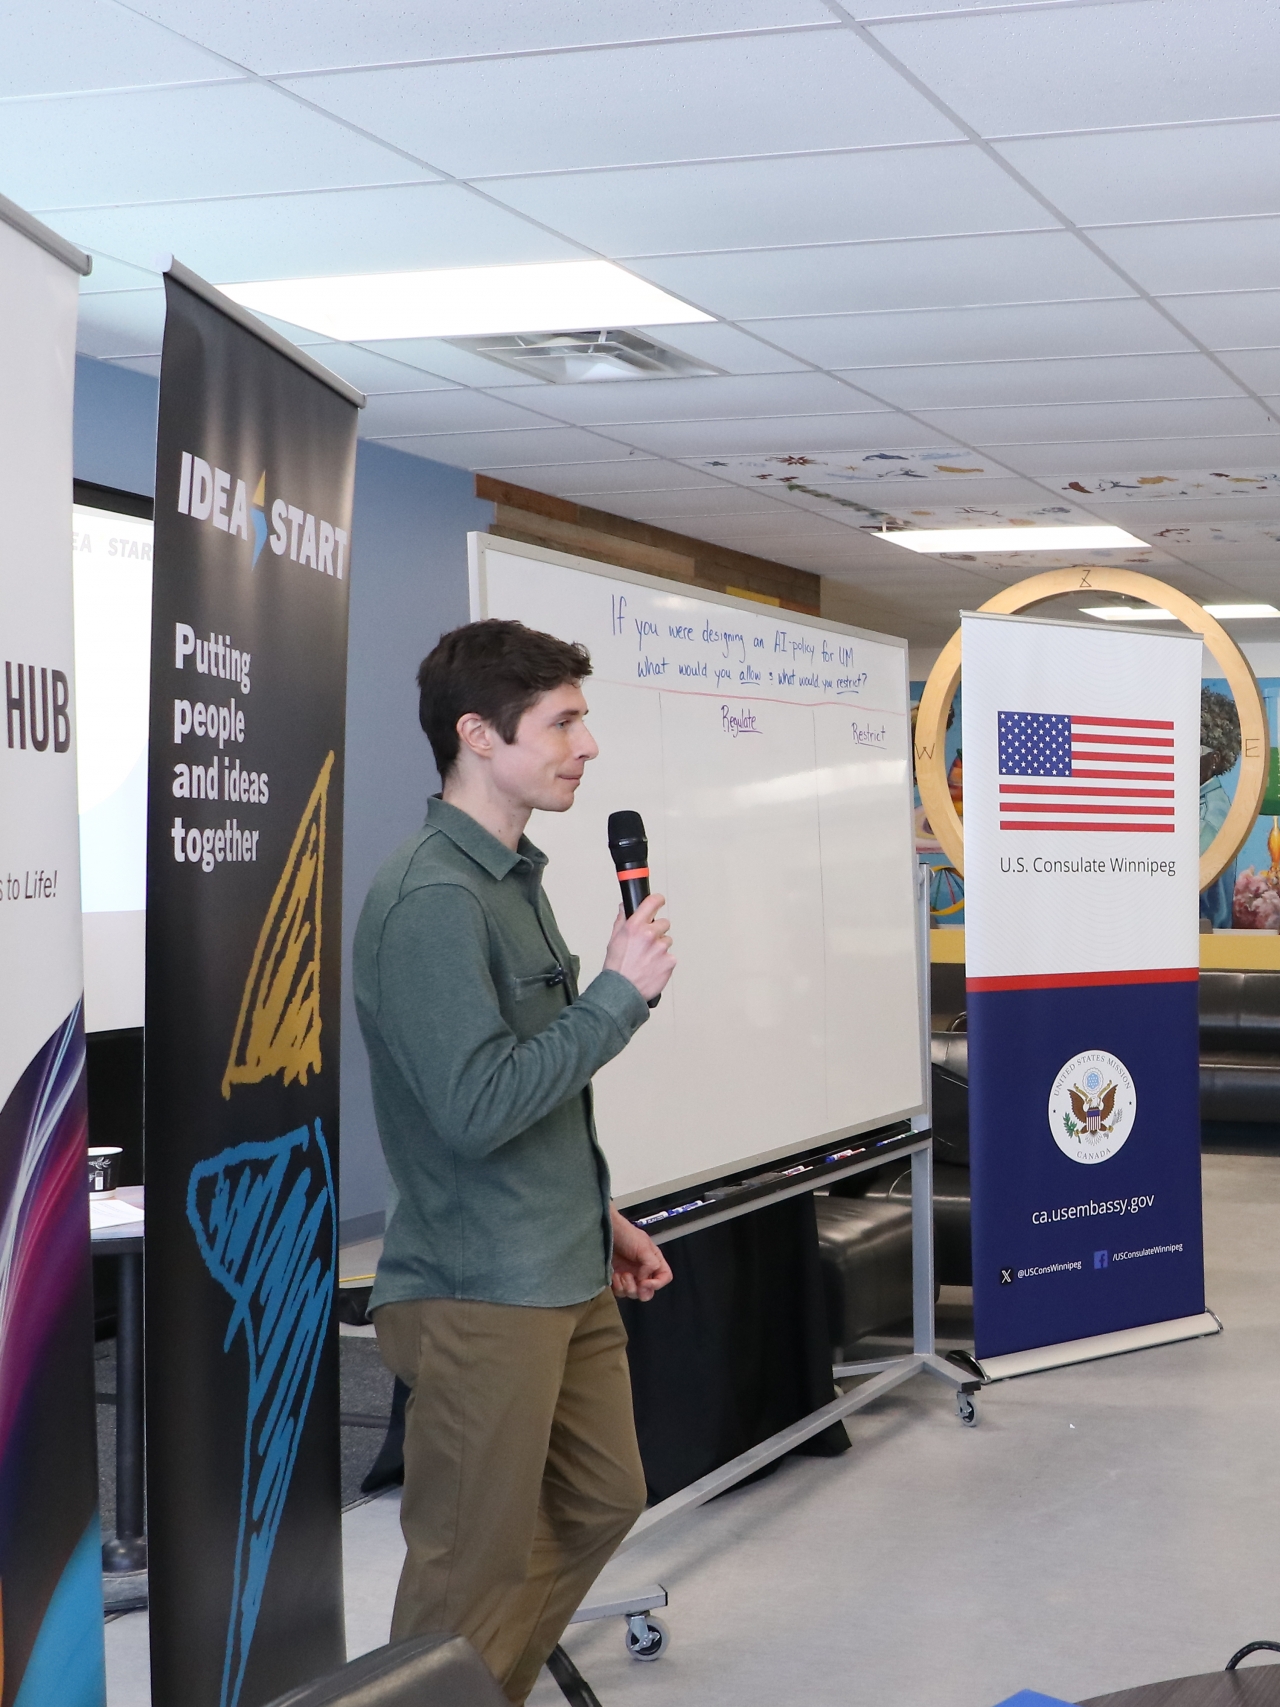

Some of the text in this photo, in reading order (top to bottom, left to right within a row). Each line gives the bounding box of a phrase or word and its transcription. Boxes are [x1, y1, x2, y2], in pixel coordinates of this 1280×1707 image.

[178, 451, 347, 580] IDEA START
[612, 594, 627, 636] If
[634, 618, 660, 652] you
[668, 625, 695, 642] were
[702, 619, 746, 664] designing
[753, 637, 765, 649] an
[821, 639, 835, 663] for
[838, 646, 854, 669] UM
[175, 622, 251, 695] Putting
[678, 661, 708, 678] would
[714, 668, 732, 689] you
[739, 665, 761, 681] allow
[798, 672, 820, 689] would
[822, 680, 833, 694] you
[835, 672, 868, 690] restrict?
[5, 660, 71, 754] HUB
[173, 697, 245, 750] people
[720, 705, 757, 738] Regulate
[851, 722, 886, 744] Restrict
[172, 755, 269, 805] and ideas
[171, 817, 259, 873] together
[1000, 856, 1176, 877] U.S. Consulate Winnipeg
[7, 872, 21, 901] to
[25, 869, 58, 899] Life!
[1053, 1054, 1132, 1097] UNITED STATES MISSION
[1076, 1147, 1112, 1160] CANADA
[1032, 1194, 1155, 1225] ca.usembassy.gov
[1112, 1243, 1183, 1262] /USConsulateWinnipeg
[1017, 1260, 1082, 1279] @USConsWinnipeg
